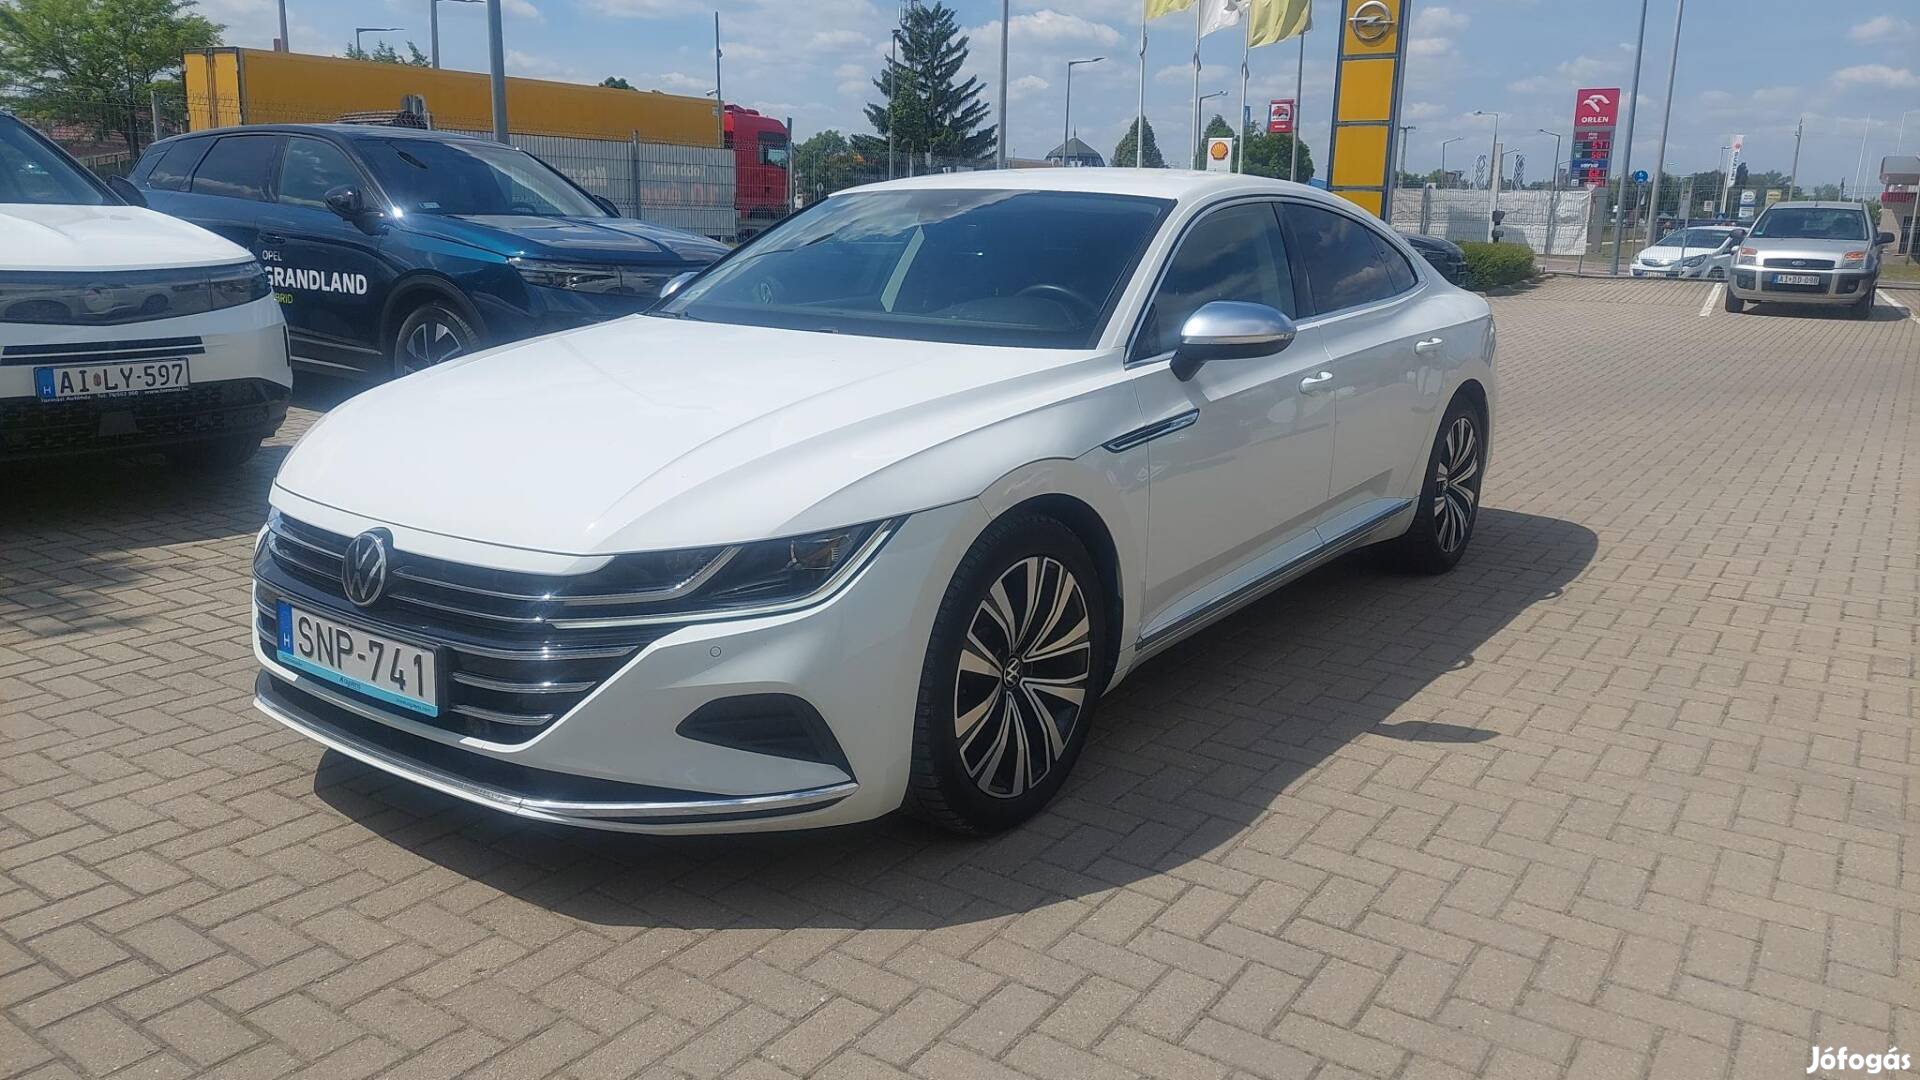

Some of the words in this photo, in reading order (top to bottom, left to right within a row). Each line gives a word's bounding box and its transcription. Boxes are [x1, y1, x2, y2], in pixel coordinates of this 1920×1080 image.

[262, 250, 283, 262] OPEL
[264, 266, 368, 295] GRANDLAND
[274, 293, 294, 304] BRID
[43, 386, 52, 395] H
[283, 633, 290, 648] H
[298, 616, 425, 698] SNP-741
